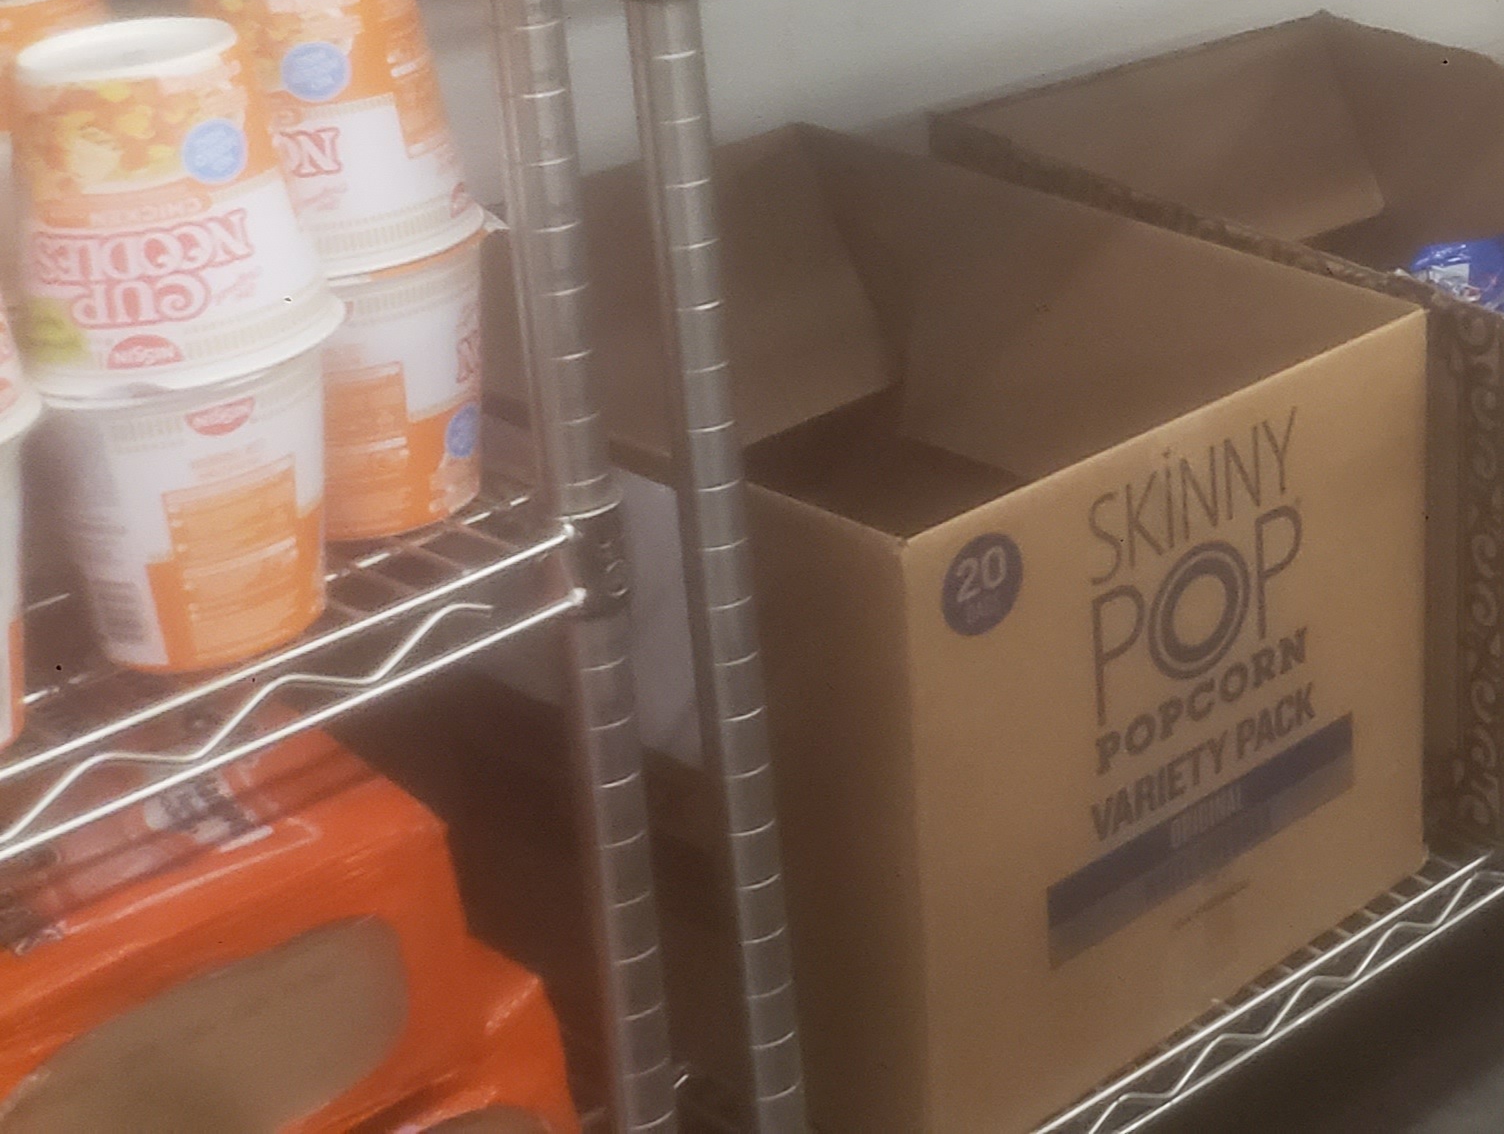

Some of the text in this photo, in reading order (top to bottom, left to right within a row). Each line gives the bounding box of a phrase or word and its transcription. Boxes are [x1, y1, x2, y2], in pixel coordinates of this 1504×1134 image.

[72, 272, 212, 330] CUP
[956, 545, 1007, 603] 20
[1092, 506, 1303, 724] POP
[1091, 682, 1317, 843] VARIETY PACK
[1096, 627, 1308, 776] POPCORN
